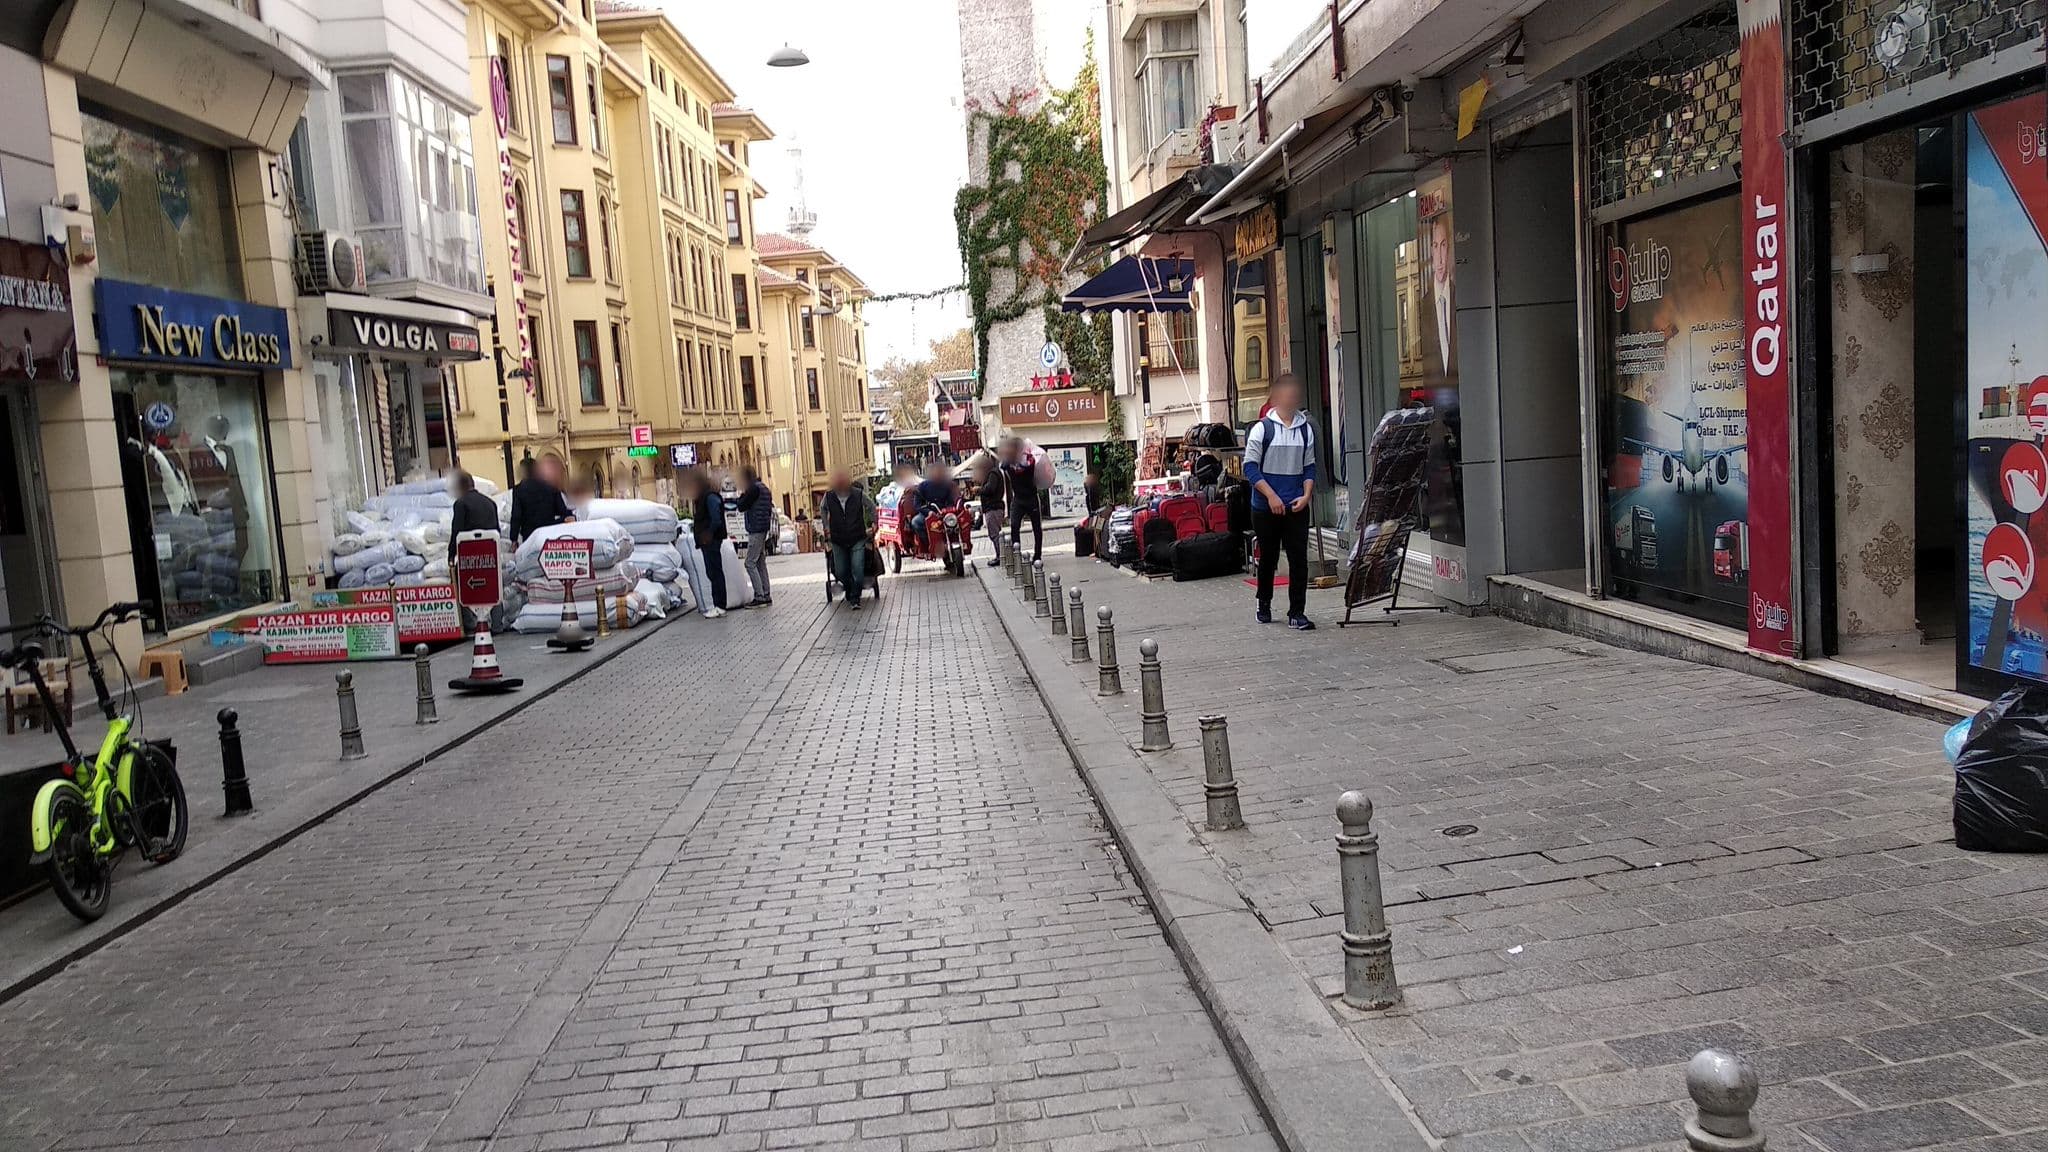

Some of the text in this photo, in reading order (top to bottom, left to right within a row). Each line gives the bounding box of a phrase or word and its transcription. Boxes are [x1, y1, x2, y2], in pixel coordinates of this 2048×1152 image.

[0, 275, 66, 312] NTANA
[1751, 195, 1781, 377] Qatar
[136, 303, 280, 364] New Class
[353, 316, 439, 352] VOLGA
[1009, 398, 1097, 414] HOTEL EYFEL
[635, 427, 649, 444] E
[1696, 425, 1717, 438] Qatar
[1722, 425, 1739, 436] UAE
[572, 551, 587, 560] ТУР
[544, 560, 572, 568] КАРГО
[418, 586, 452, 600] KARGO
[401, 601, 454, 613] ТУР КАРГО
[257, 614, 305, 627] KAZAN
[309, 613, 338, 625] TUR
[342, 611, 390, 623] KARGO
[299, 626, 313, 635] ТУР
[315, 625, 344, 634] КАРГО
